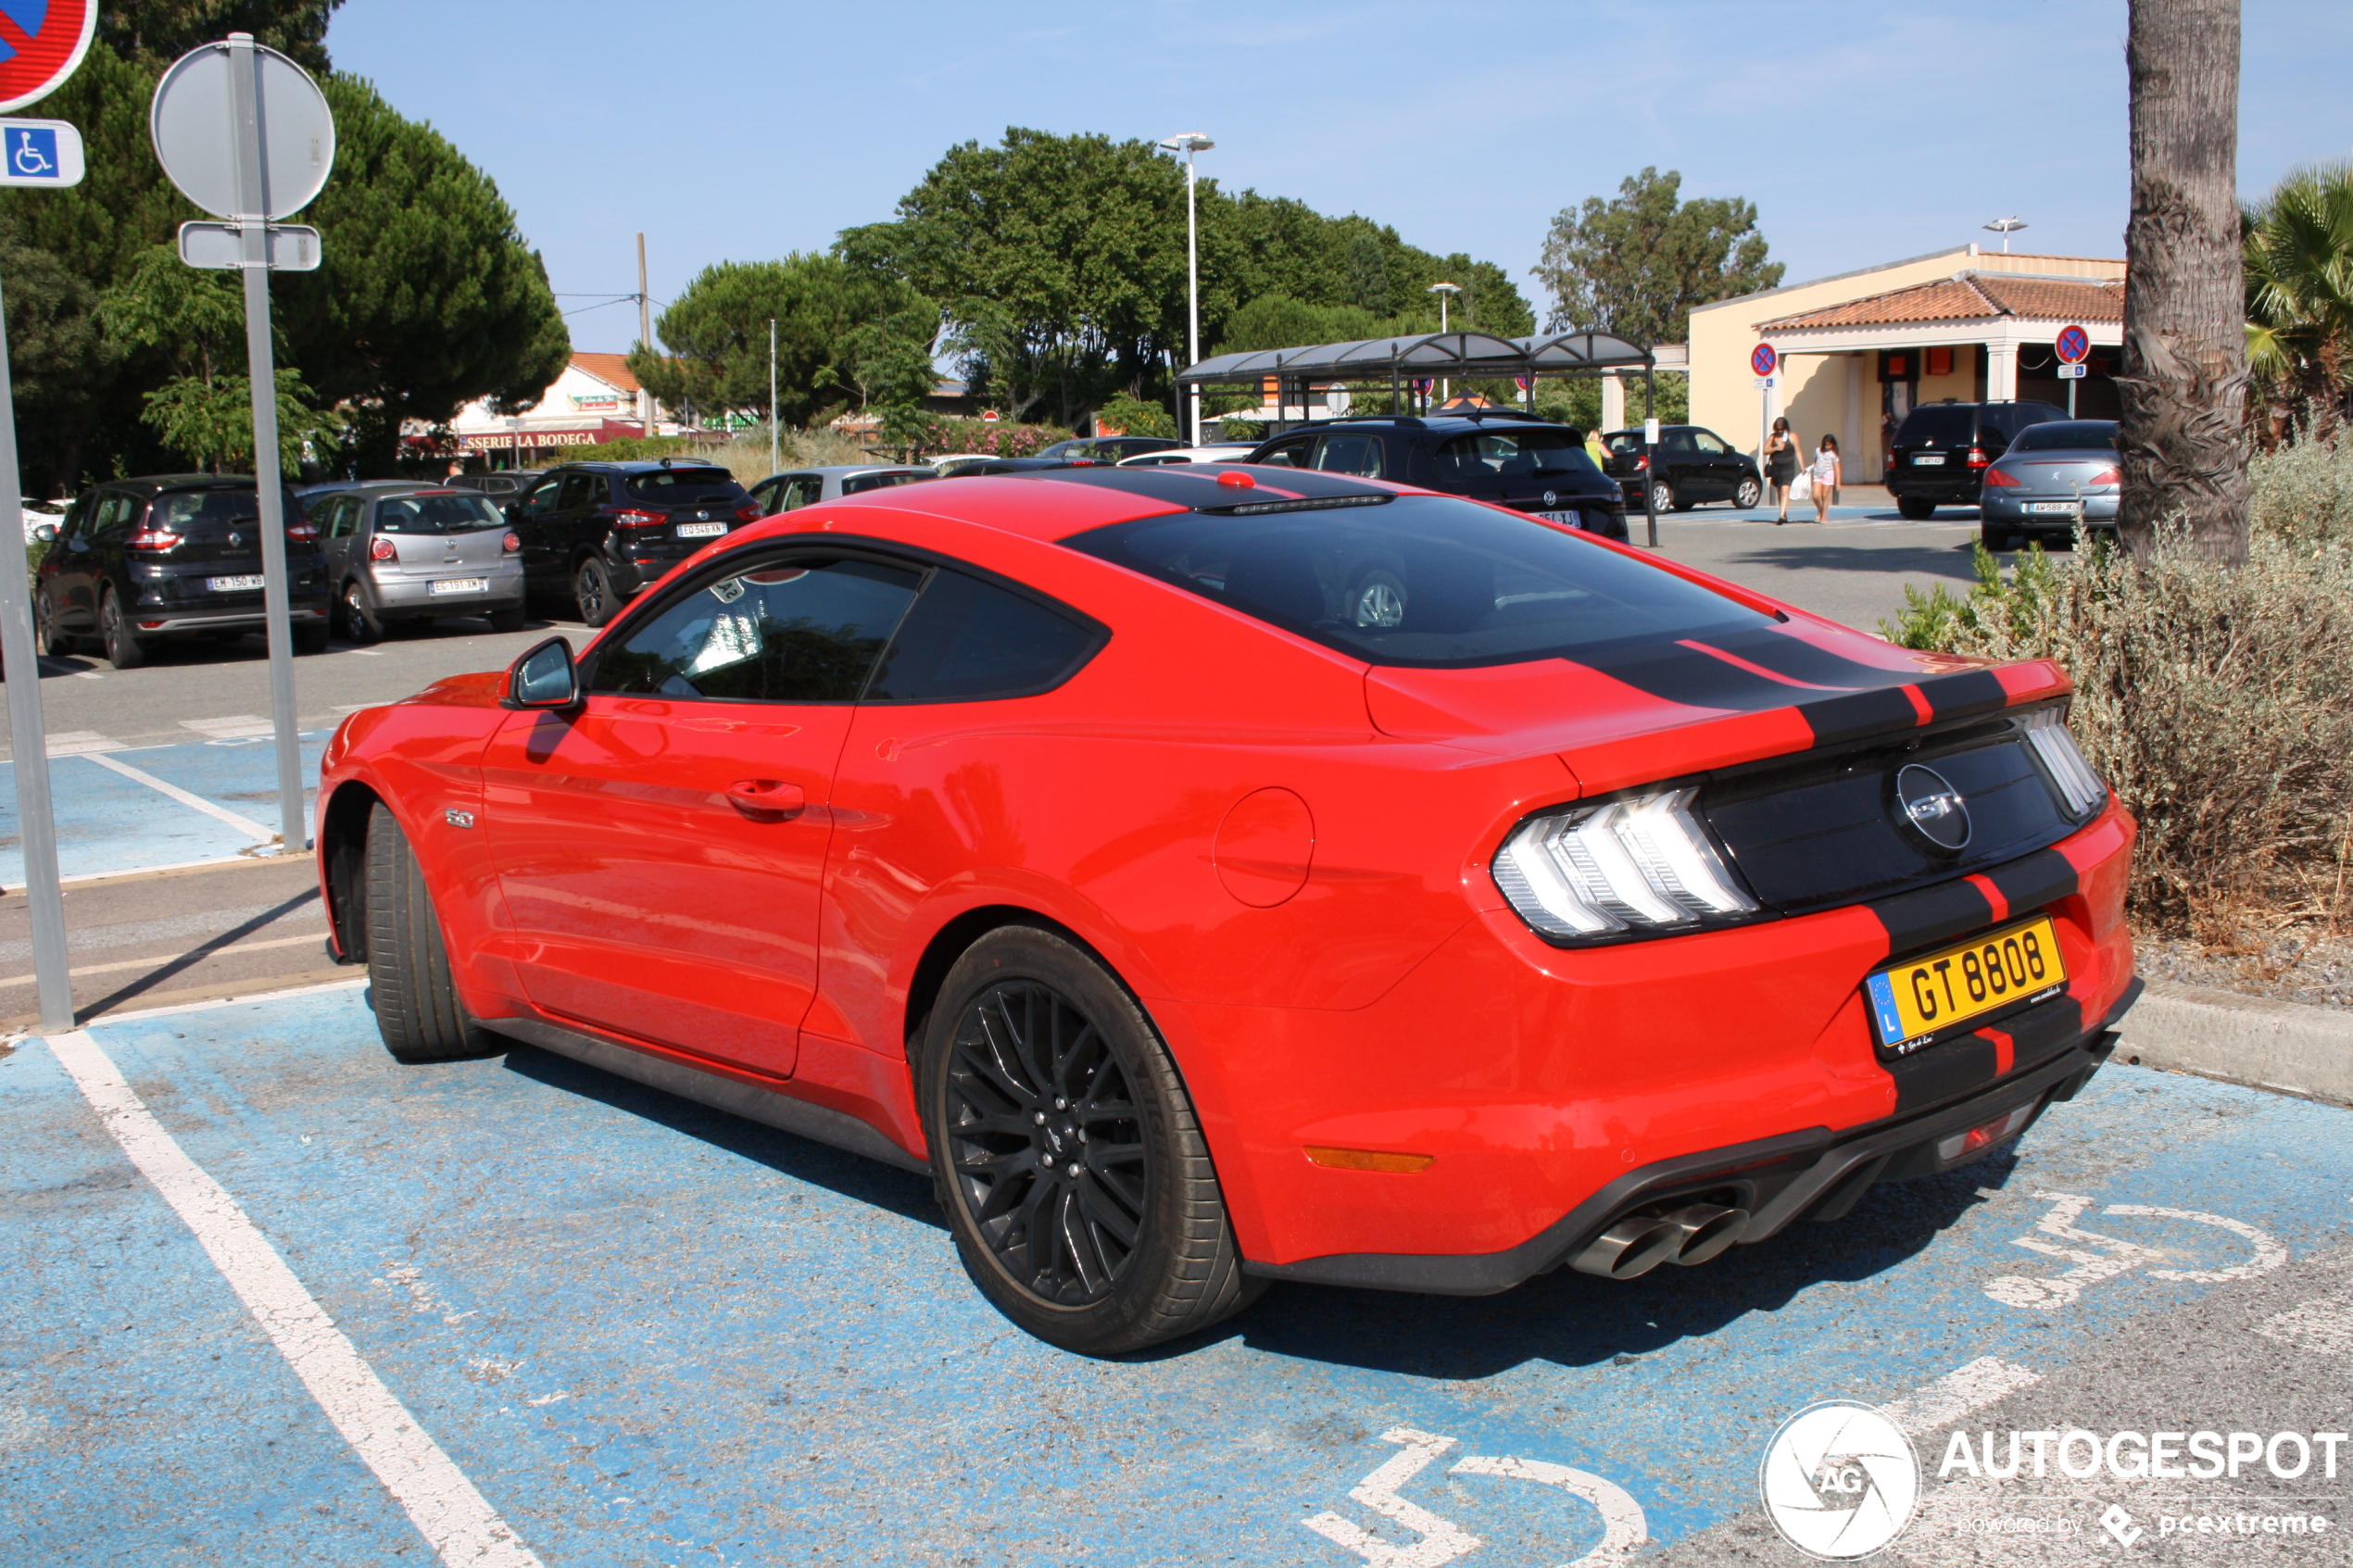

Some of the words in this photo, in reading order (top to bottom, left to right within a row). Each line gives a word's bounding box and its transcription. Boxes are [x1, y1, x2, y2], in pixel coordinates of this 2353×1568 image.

[517, 435, 535, 447] LA
[537, 433, 597, 446] BODEGA
[1911, 959, 1956, 1021] GT
[1961, 931, 2045, 1002] 8808
[1883, 1014, 1896, 1032] L
